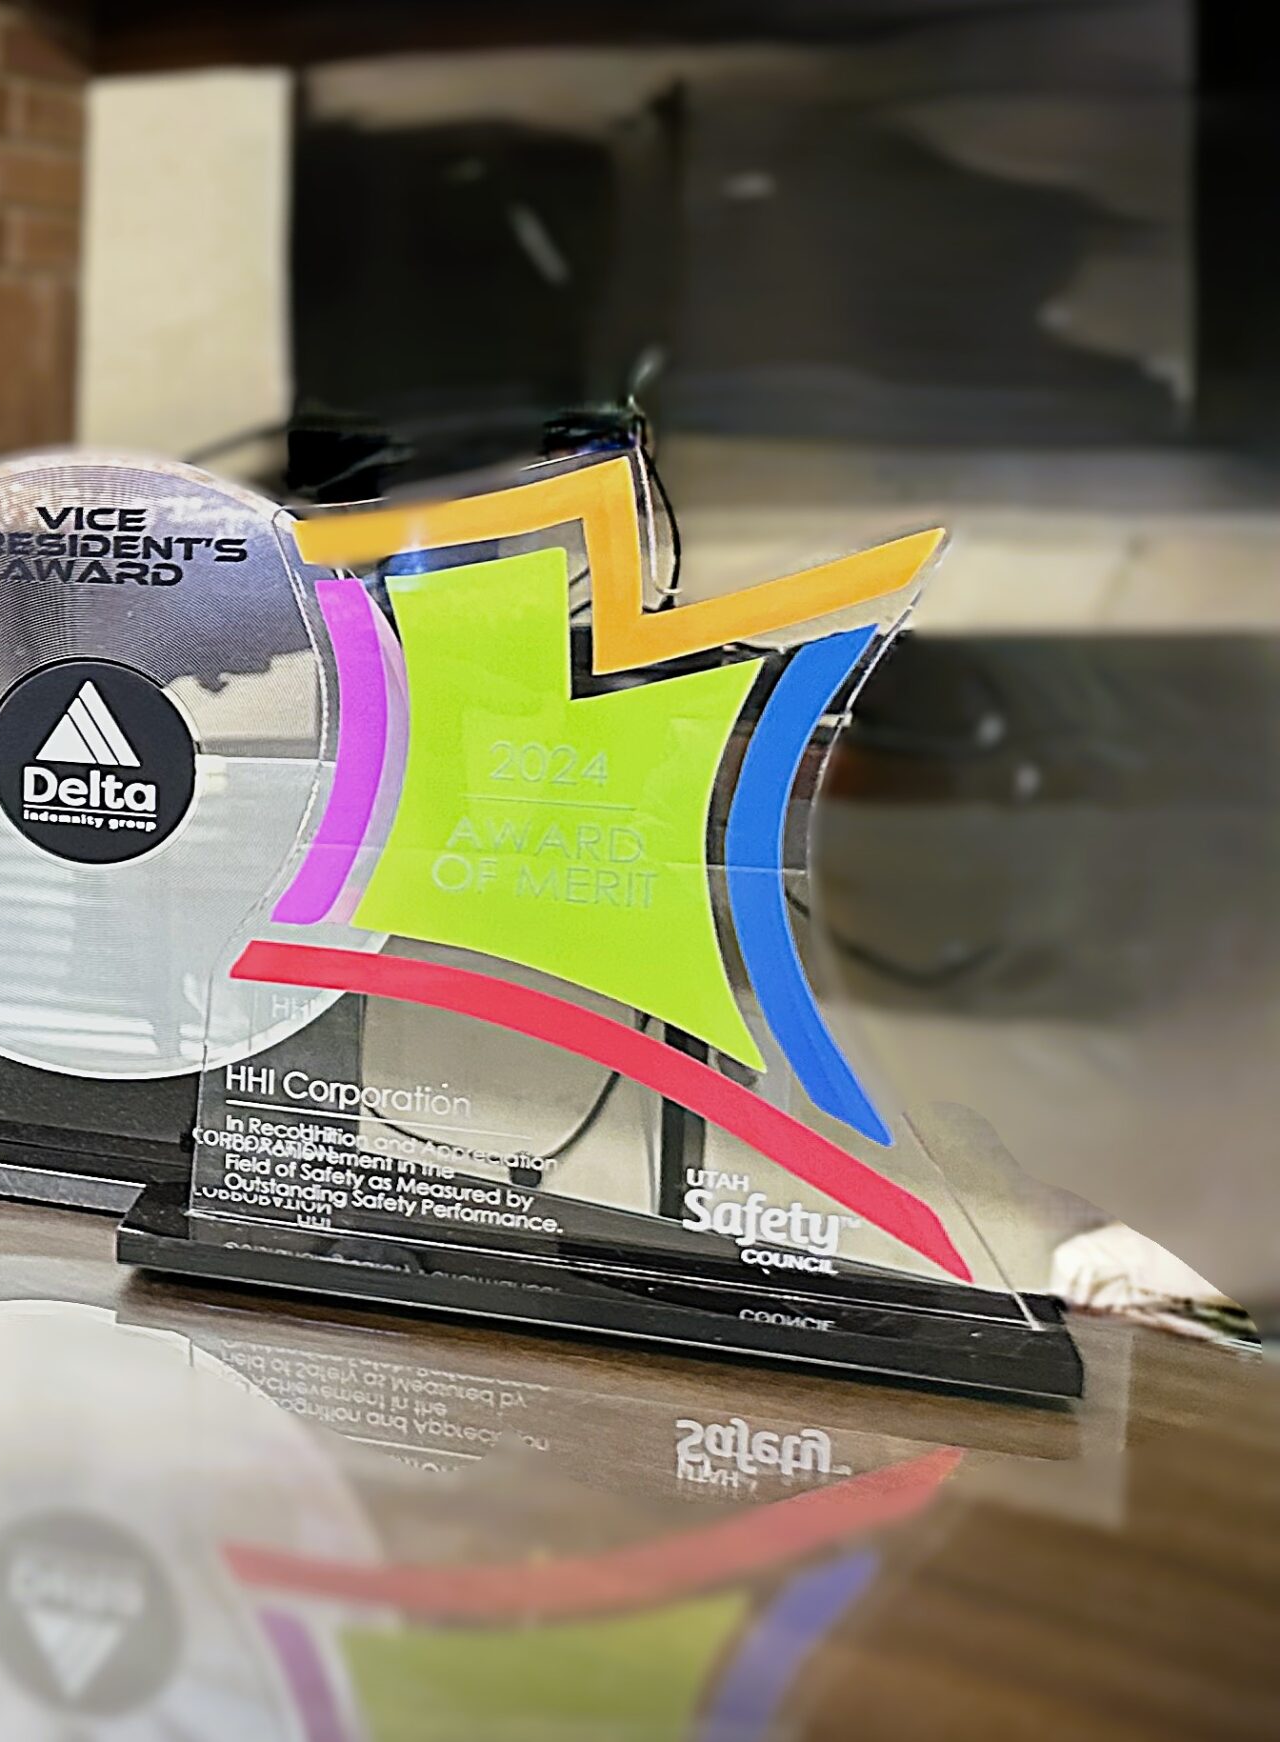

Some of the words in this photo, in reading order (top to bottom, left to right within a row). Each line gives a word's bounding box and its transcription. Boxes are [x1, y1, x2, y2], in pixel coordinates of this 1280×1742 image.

[35, 506, 147, 532] VICE
[0, 557, 183, 587] AWARD
[489, 740, 609, 786] 2024
[23, 766, 156, 812] Delta
[23, 809, 104, 829] indemnity
[108, 818, 157, 832] group
[445, 816, 645, 864] AWARD
[431, 853, 498, 894] OF
[515, 862, 658, 909] MERIT
[226, 1064, 275, 1096] HHI
[282, 1070, 472, 1118] Corporation
[226, 1115, 244, 1132] In
[374, 1135, 417, 1154] and
[420, 1140, 558, 1171] Appreciation
[224, 1172, 348, 1209] Outstanding
[352, 1190, 417, 1217] Safety
[421, 1199, 564, 1234] Performance.
[225, 1153, 271, 1174] Field
[275, 1161, 297, 1178] of
[300, 1163, 366, 1189] Safety
[368, 1175, 392, 1191] as
[396, 1177, 502, 1206] Measured
[507, 1190, 535, 1213] by
[686, 1169, 749, 1192] UTAH
[682, 1189, 840, 1255] Safety
[741, 1249, 839, 1276] COUNCIL
